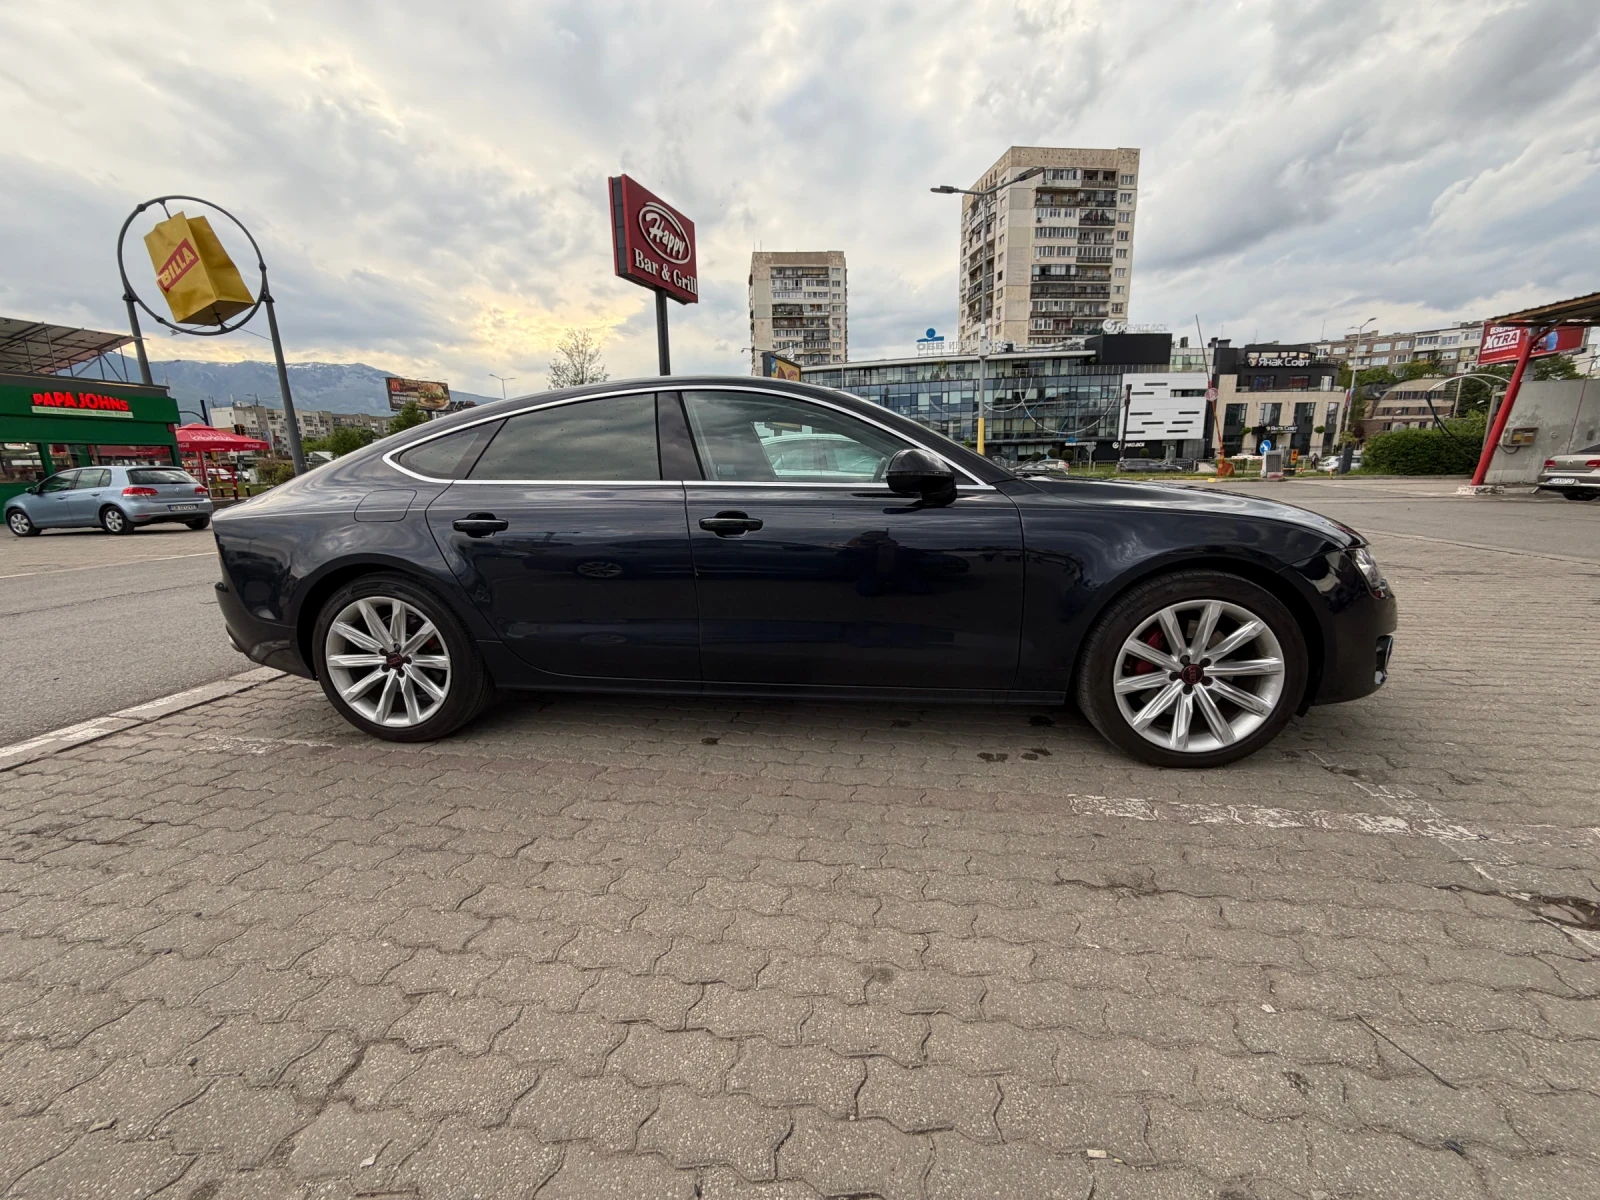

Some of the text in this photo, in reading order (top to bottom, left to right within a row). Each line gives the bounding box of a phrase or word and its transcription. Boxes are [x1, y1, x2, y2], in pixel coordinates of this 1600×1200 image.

[645, 212, 685, 259] Happy
[161, 246, 195, 287] BILLA
[634, 247, 698, 295] Bar & Grill
[1482, 330, 1519, 350] XTRA
[33, 391, 129, 411] PAPA JOHNS
